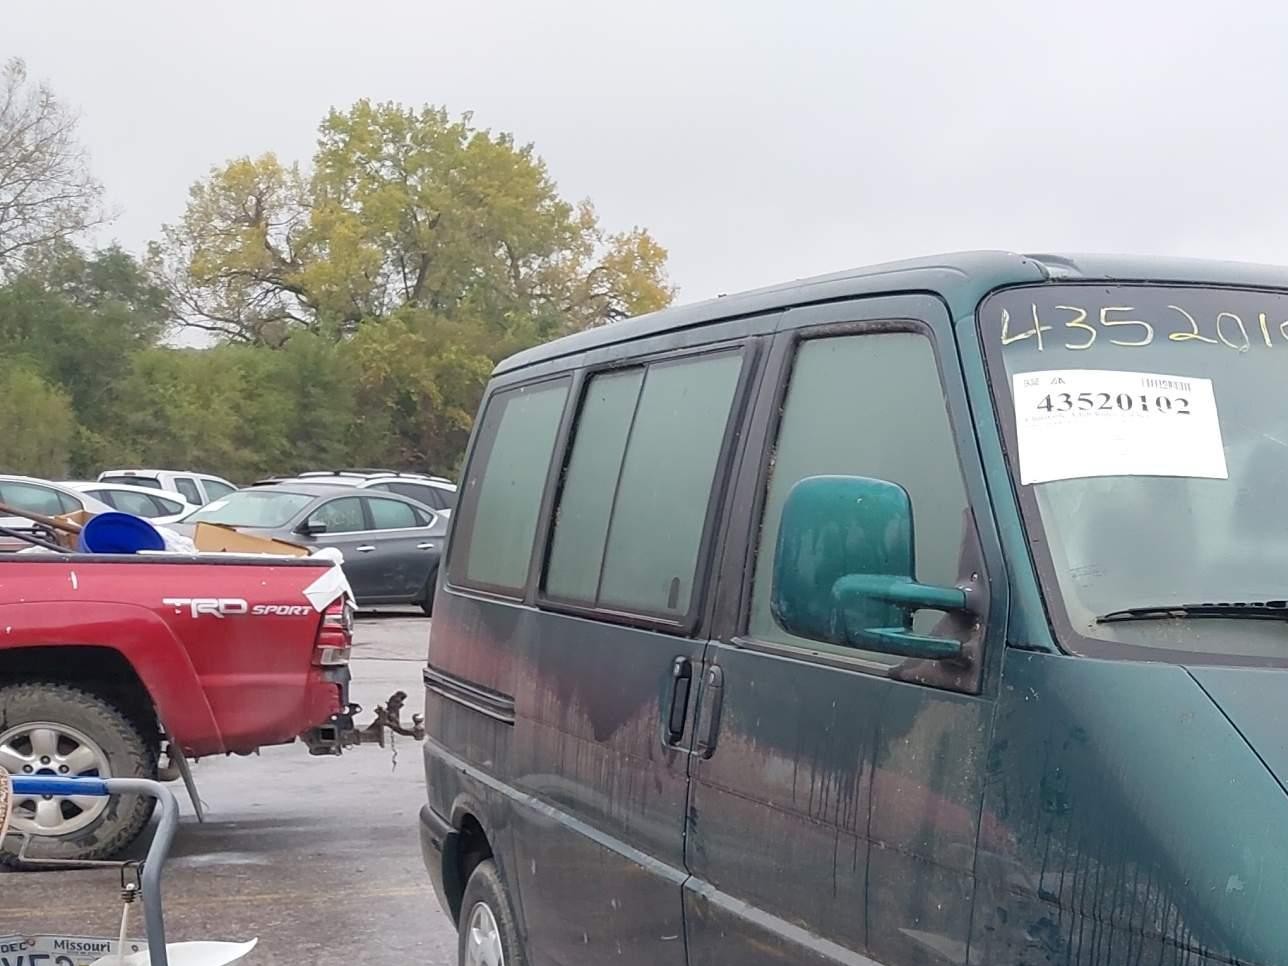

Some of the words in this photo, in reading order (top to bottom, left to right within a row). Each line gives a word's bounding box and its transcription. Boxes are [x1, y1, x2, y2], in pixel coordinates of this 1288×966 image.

[1036, 391, 1192, 415] 43520102
[162, 597, 249, 619] TRD
[250, 604, 314, 616] SPORT
[54, 938, 111, 953] Missouri
